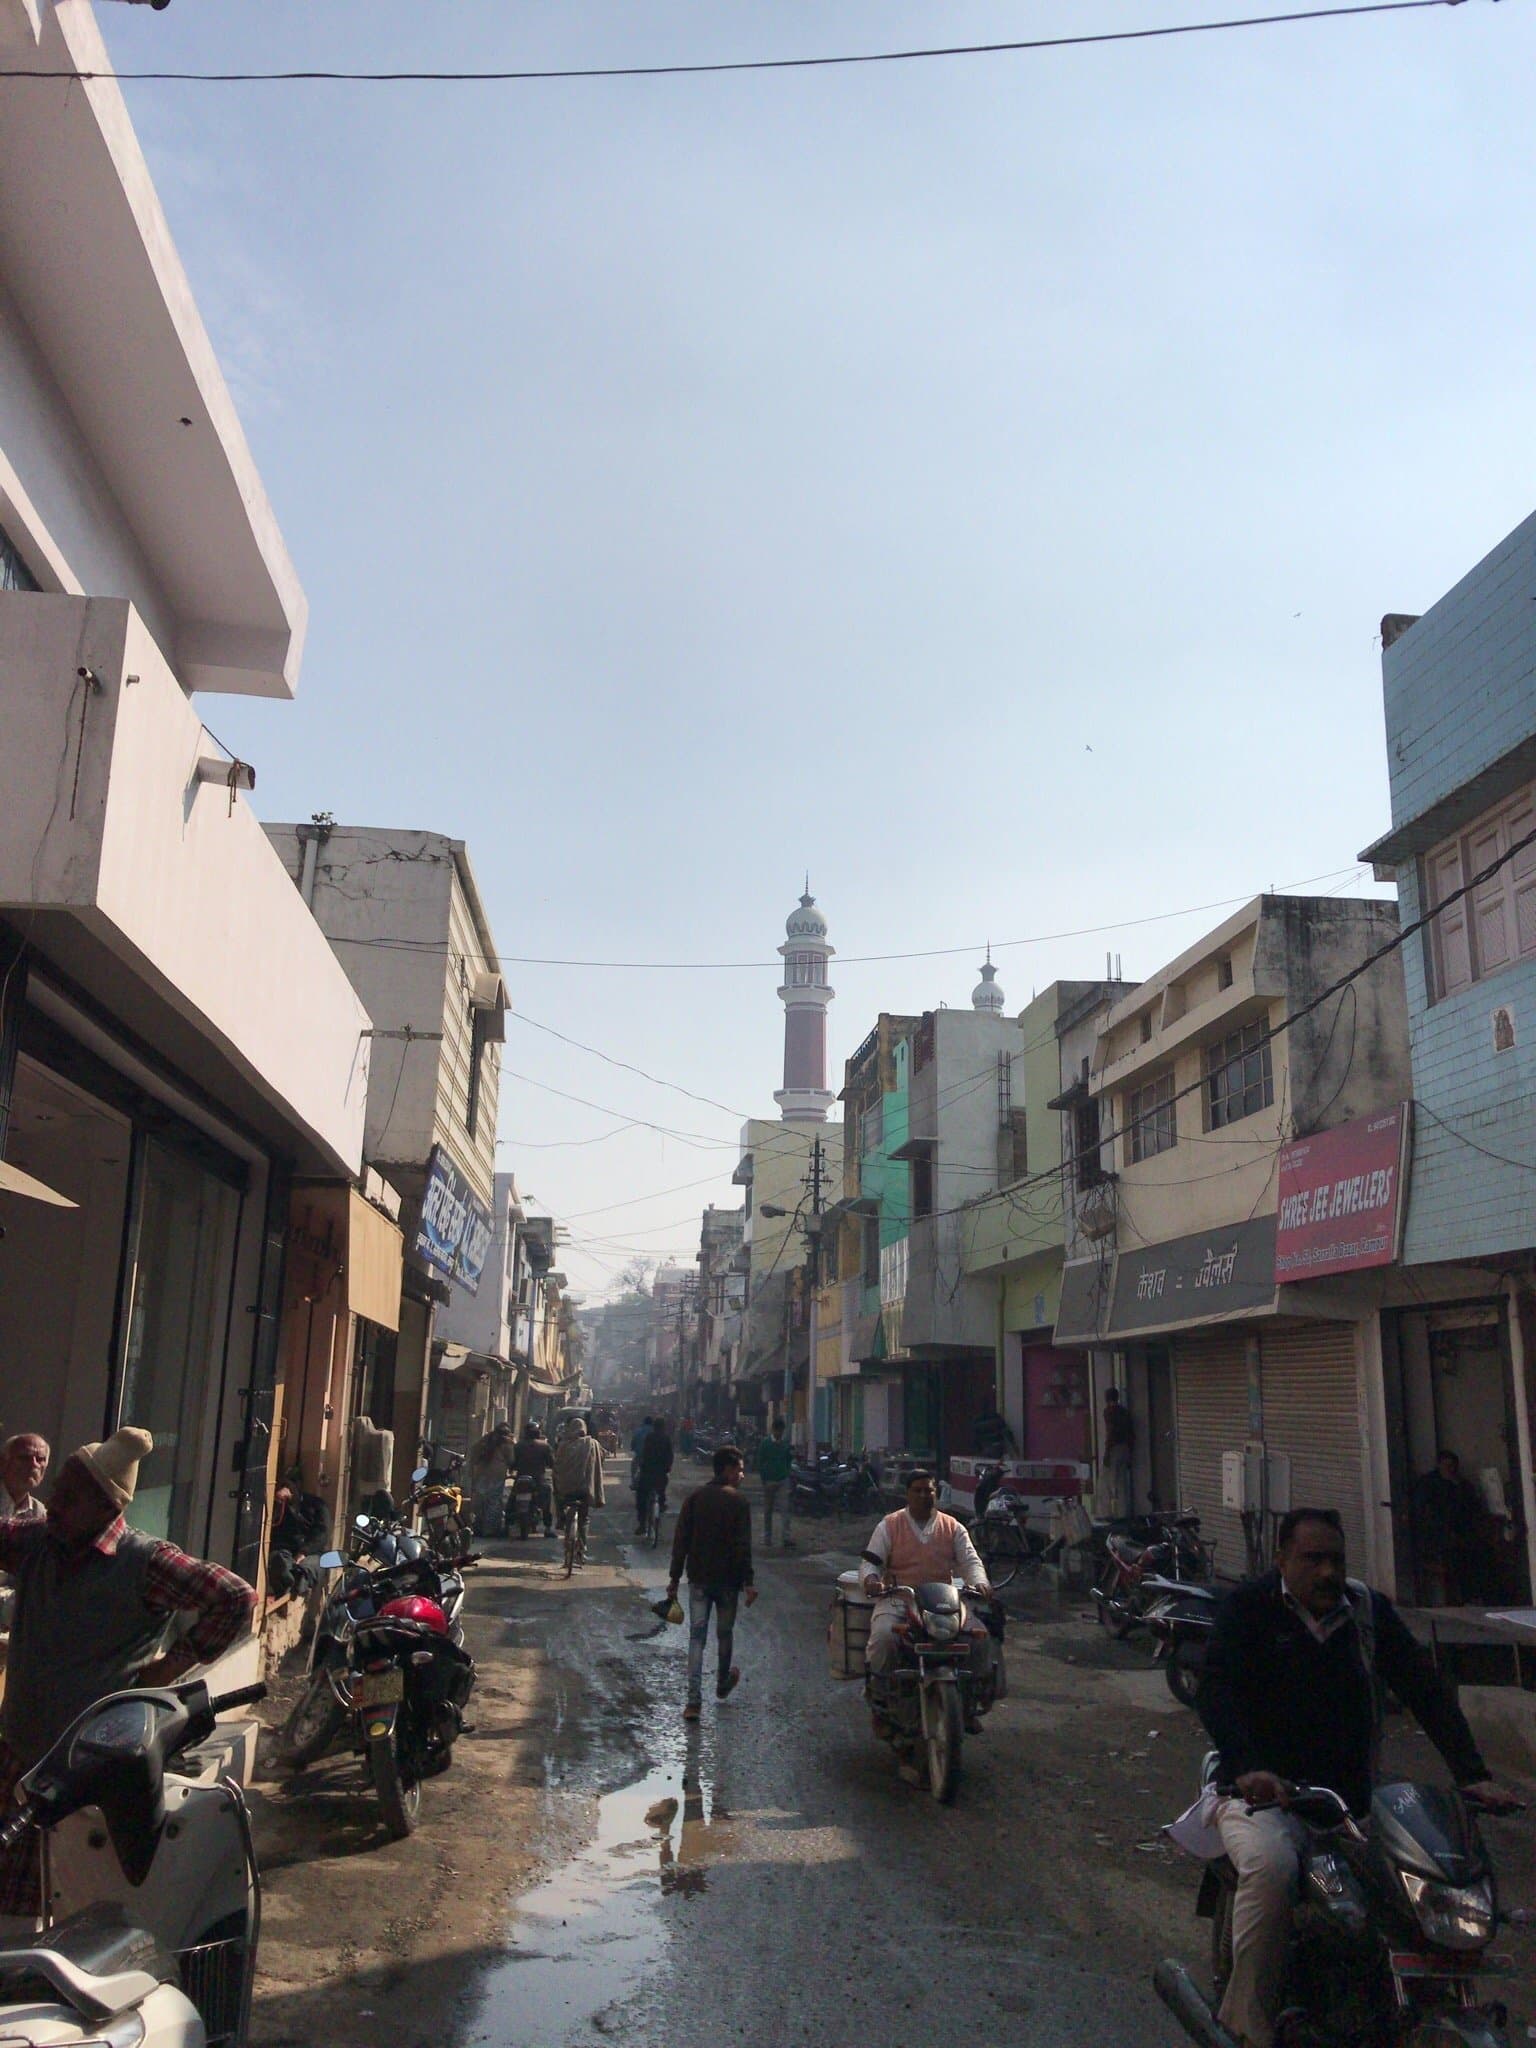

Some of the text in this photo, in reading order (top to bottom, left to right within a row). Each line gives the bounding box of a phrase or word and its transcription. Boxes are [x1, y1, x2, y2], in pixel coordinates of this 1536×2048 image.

[1279, 1166, 1394, 1231] SHREE JEE JEWELLERS
[1137, 1265, 1166, 1303] केशव
